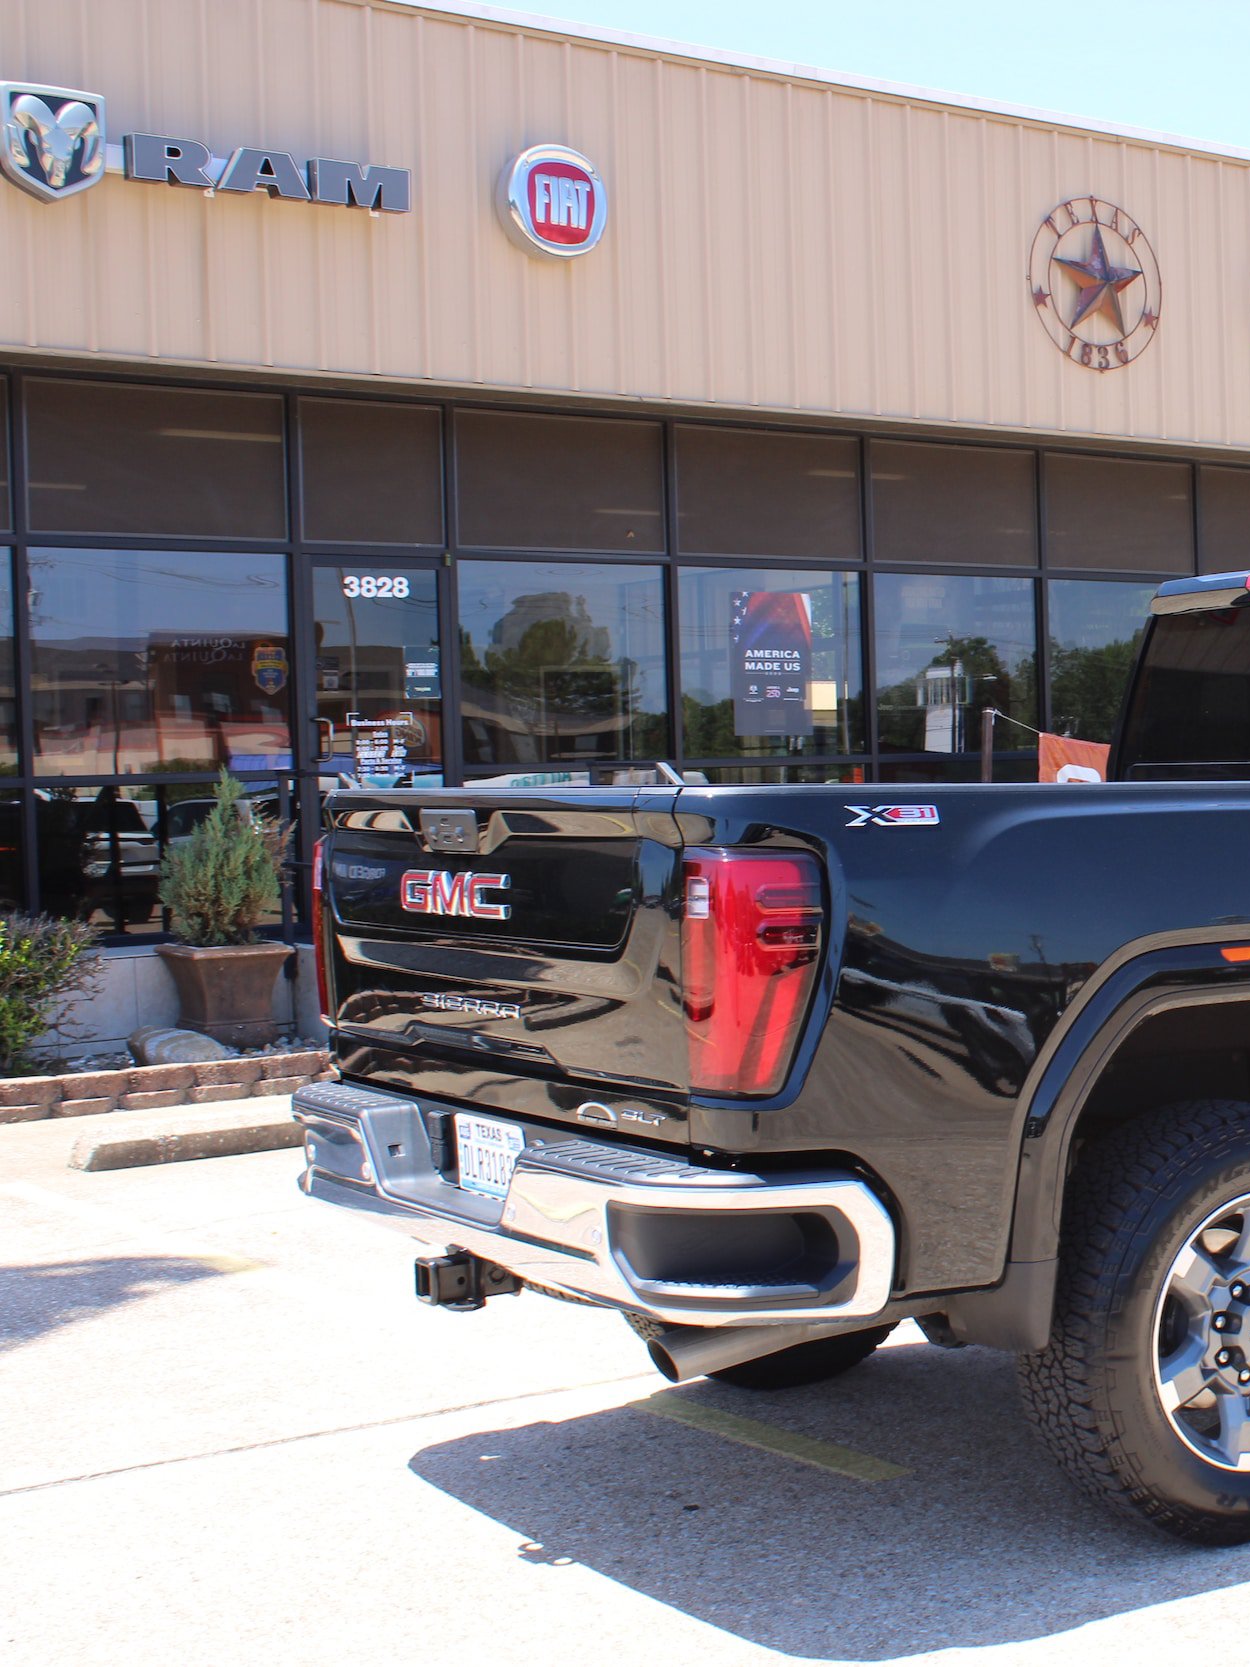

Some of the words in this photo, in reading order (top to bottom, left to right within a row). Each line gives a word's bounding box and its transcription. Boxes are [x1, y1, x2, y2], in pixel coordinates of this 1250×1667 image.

[124, 132, 411, 213] RAM
[535, 173, 592, 230] FIAT
[1043, 196, 1142, 246] TEXAS
[1062, 334, 1130, 369] 1836
[342, 575, 410, 599] 3828
[744, 649, 801, 659] AMERICA
[744, 661, 781, 671] MADE
[784, 662, 801, 671] US
[351, 718, 385, 727] Business
[386, 718, 409, 726] Hours
[401, 869, 512, 920] GMC
[420, 992, 522, 1020] SIERRA
[620, 1108, 667, 1127] SLT
[475, 1122, 503, 1142] TEXAS
